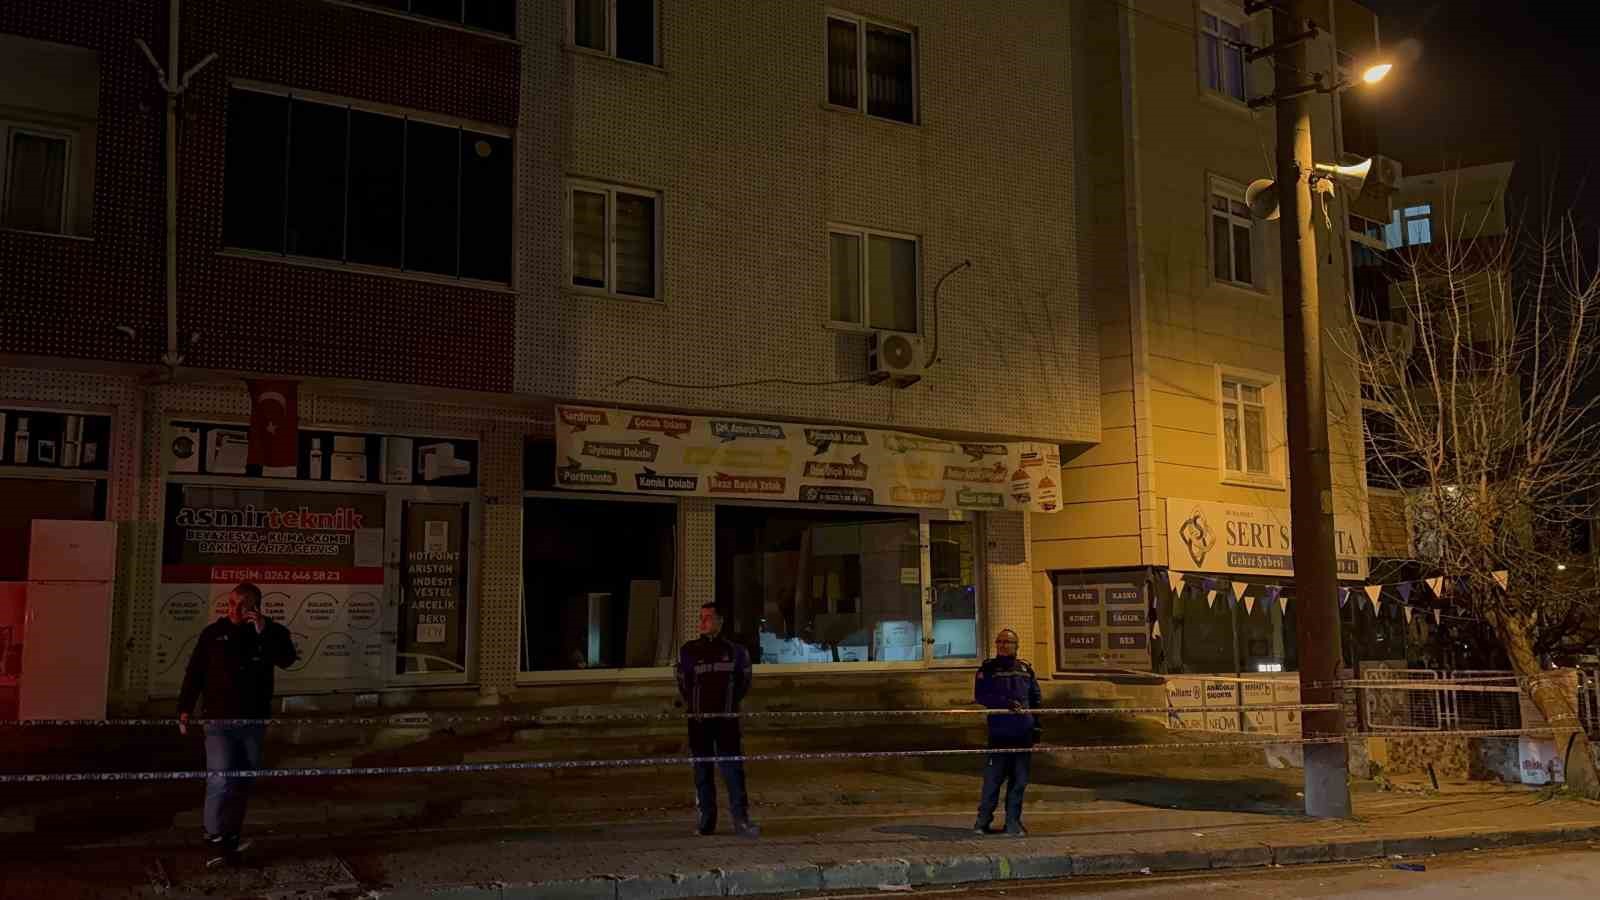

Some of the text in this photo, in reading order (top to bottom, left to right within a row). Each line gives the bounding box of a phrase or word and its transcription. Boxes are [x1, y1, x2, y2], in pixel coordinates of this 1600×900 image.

[563, 471, 613, 483] Portmanto
[1227, 520, 1275, 549] SERT
[408, 551, 461, 562] HOTPOINT
[1230, 554, 1284, 569] Gebze Şubesi
[408, 563, 454, 575] ARISTON
[263, 569, 290, 581] 0262
[291, 570, 311, 581] 646
[416, 587, 452, 598] VESTEL
[1111, 591, 1137, 600] KASKO
[418, 613, 448, 624] BEKO
[1069, 636, 1095, 646] HAYAT
[1171, 687, 1192, 698] Allianz
